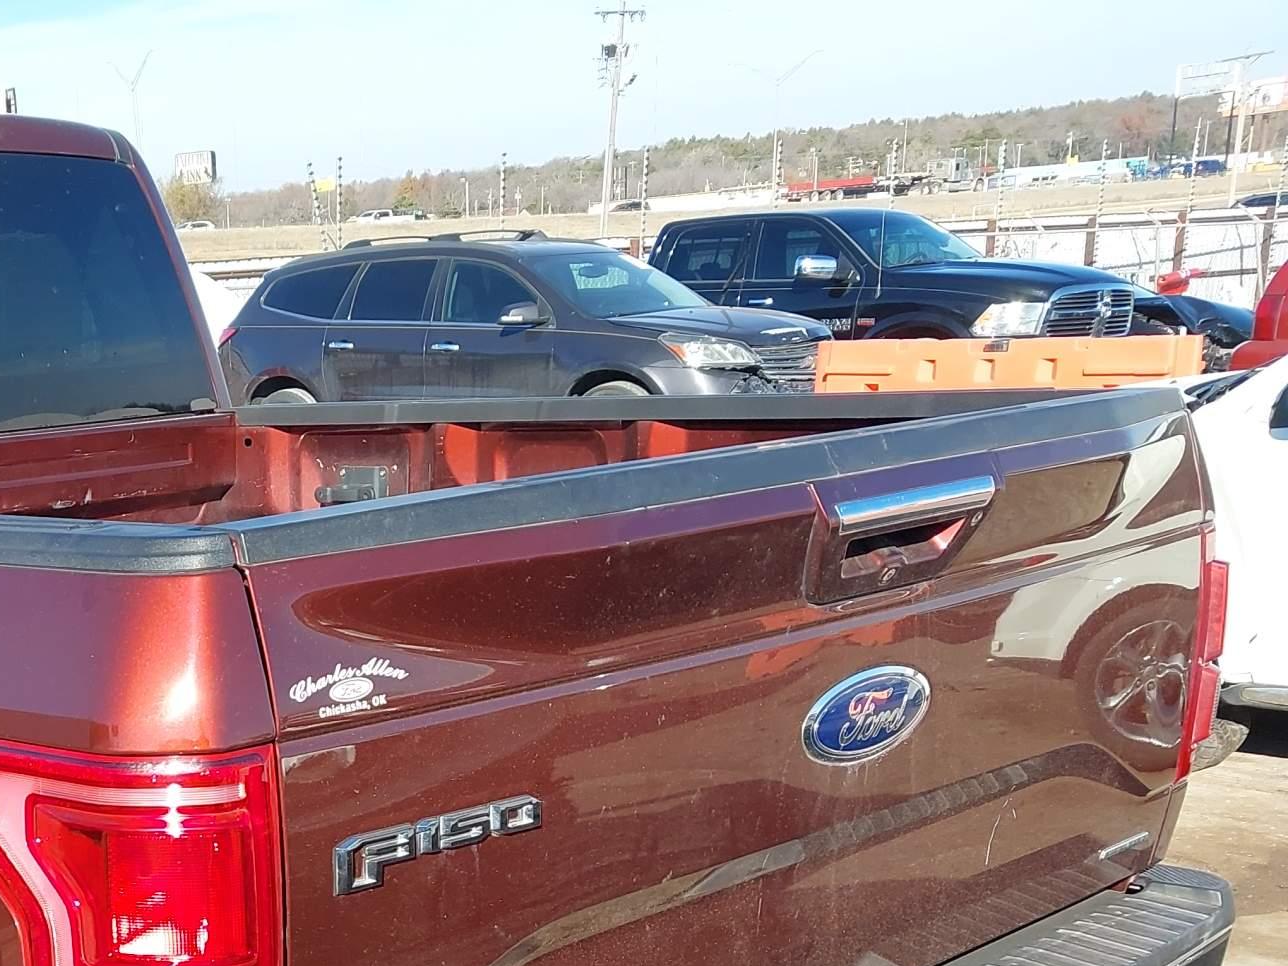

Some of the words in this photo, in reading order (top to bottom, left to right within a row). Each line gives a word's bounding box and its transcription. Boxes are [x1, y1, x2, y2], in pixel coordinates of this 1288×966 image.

[289, 663, 357, 702] Charles
[356, 656, 410, 680] Allen
[318, 699, 372, 719] Chickasha,
[371, 694, 388, 707] OK
[838, 687, 909, 751] Ford
[332, 794, 544, 897] F150
